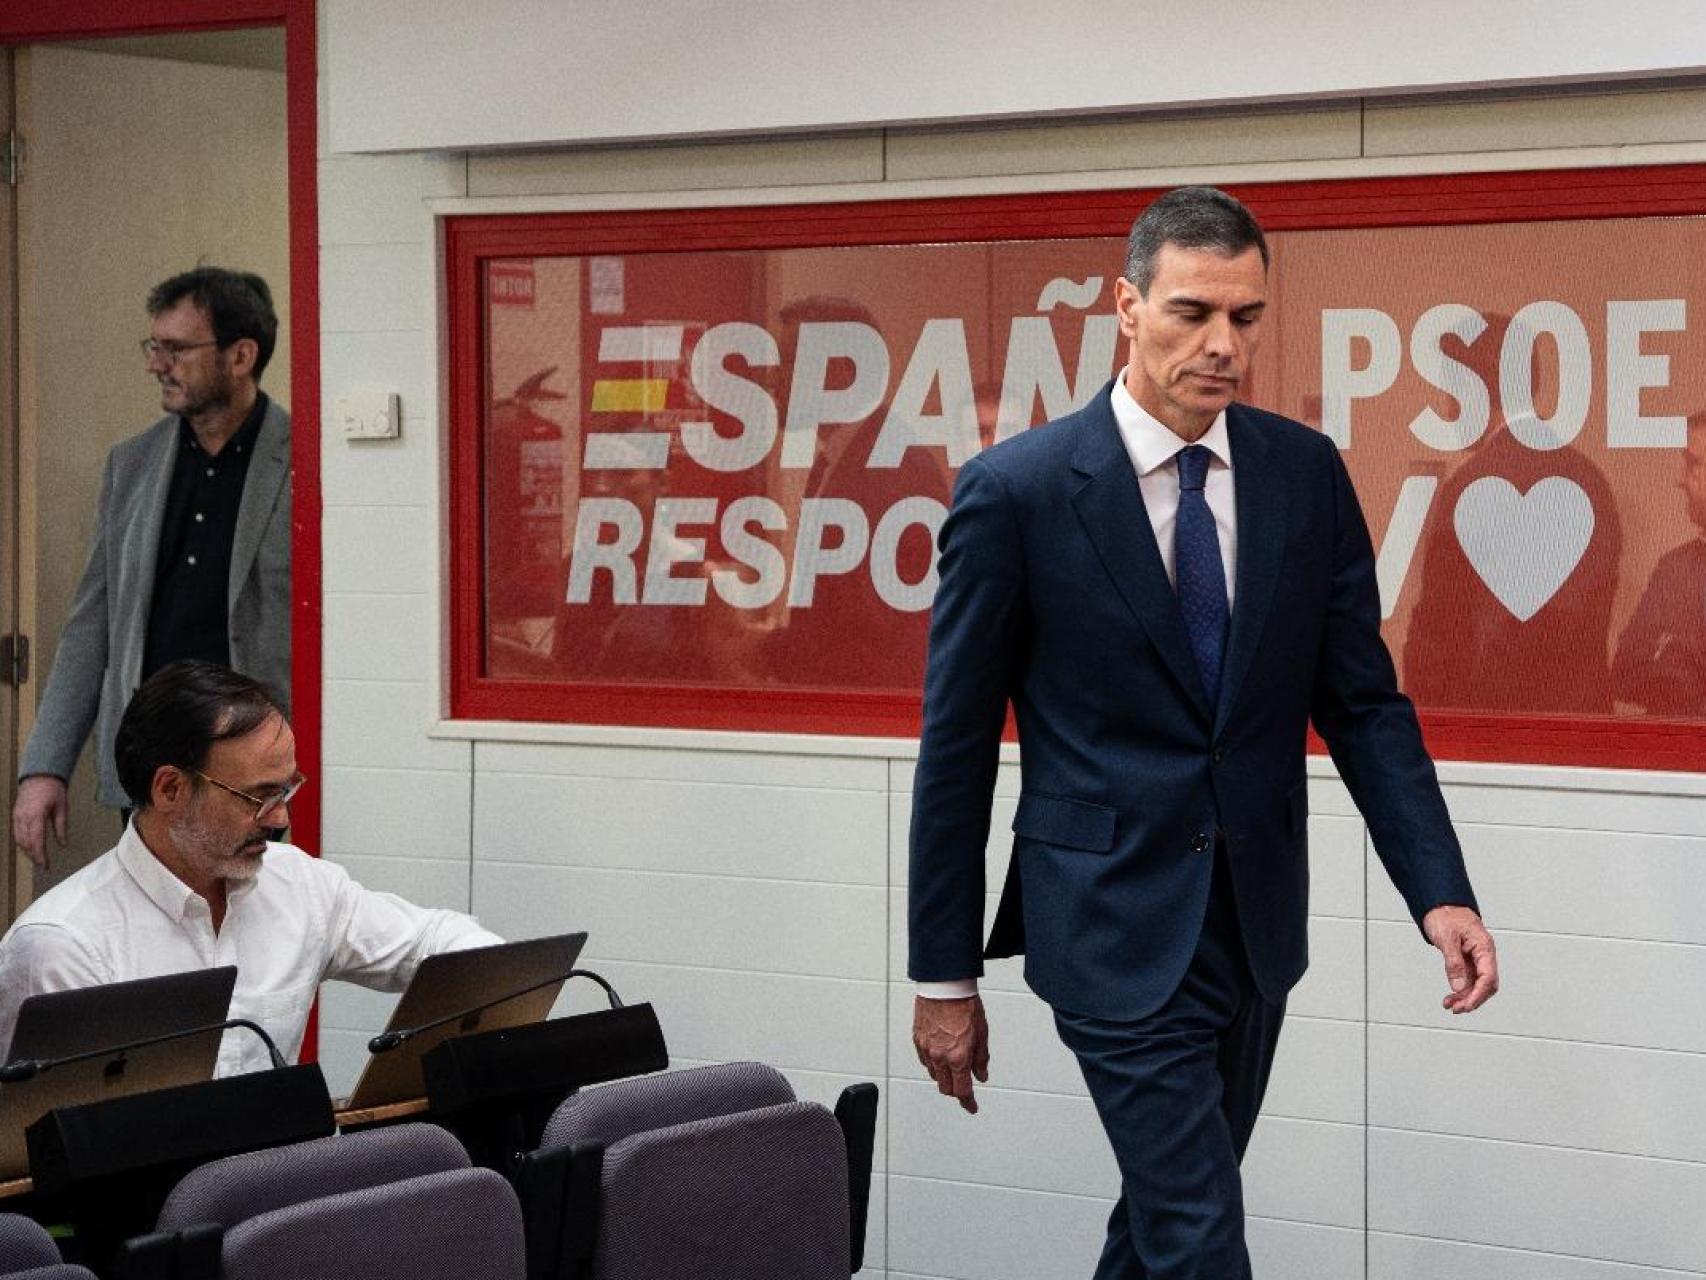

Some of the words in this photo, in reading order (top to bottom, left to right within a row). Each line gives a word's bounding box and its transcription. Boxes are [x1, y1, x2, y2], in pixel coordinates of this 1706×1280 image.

[583, 276, 1120, 472] ESPAÑ
[1321, 299, 1688, 451] PSOE
[566, 496, 950, 612] RESPO
